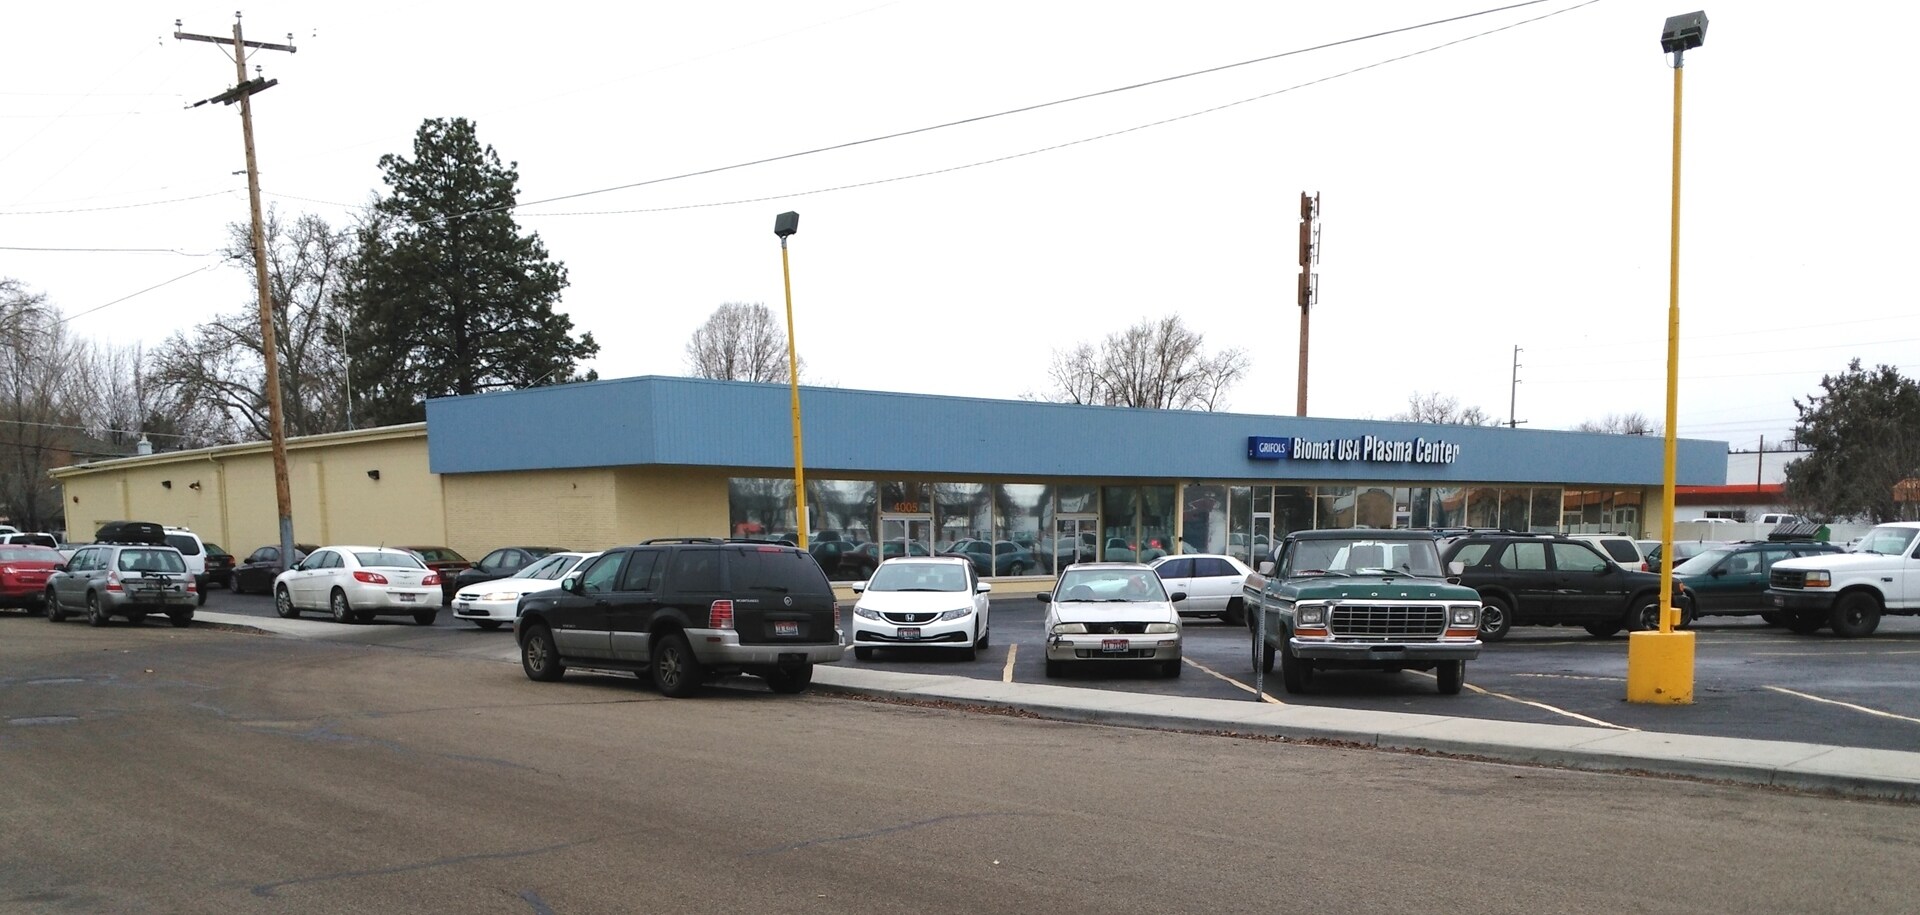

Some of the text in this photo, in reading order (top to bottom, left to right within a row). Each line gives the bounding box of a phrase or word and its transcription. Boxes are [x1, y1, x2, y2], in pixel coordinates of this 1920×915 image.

[1259, 442, 1286, 453] GRIFOLS
[1293, 435, 1460, 463] Biomat USA Plasma Center
[894, 502, 918, 513] 4005
